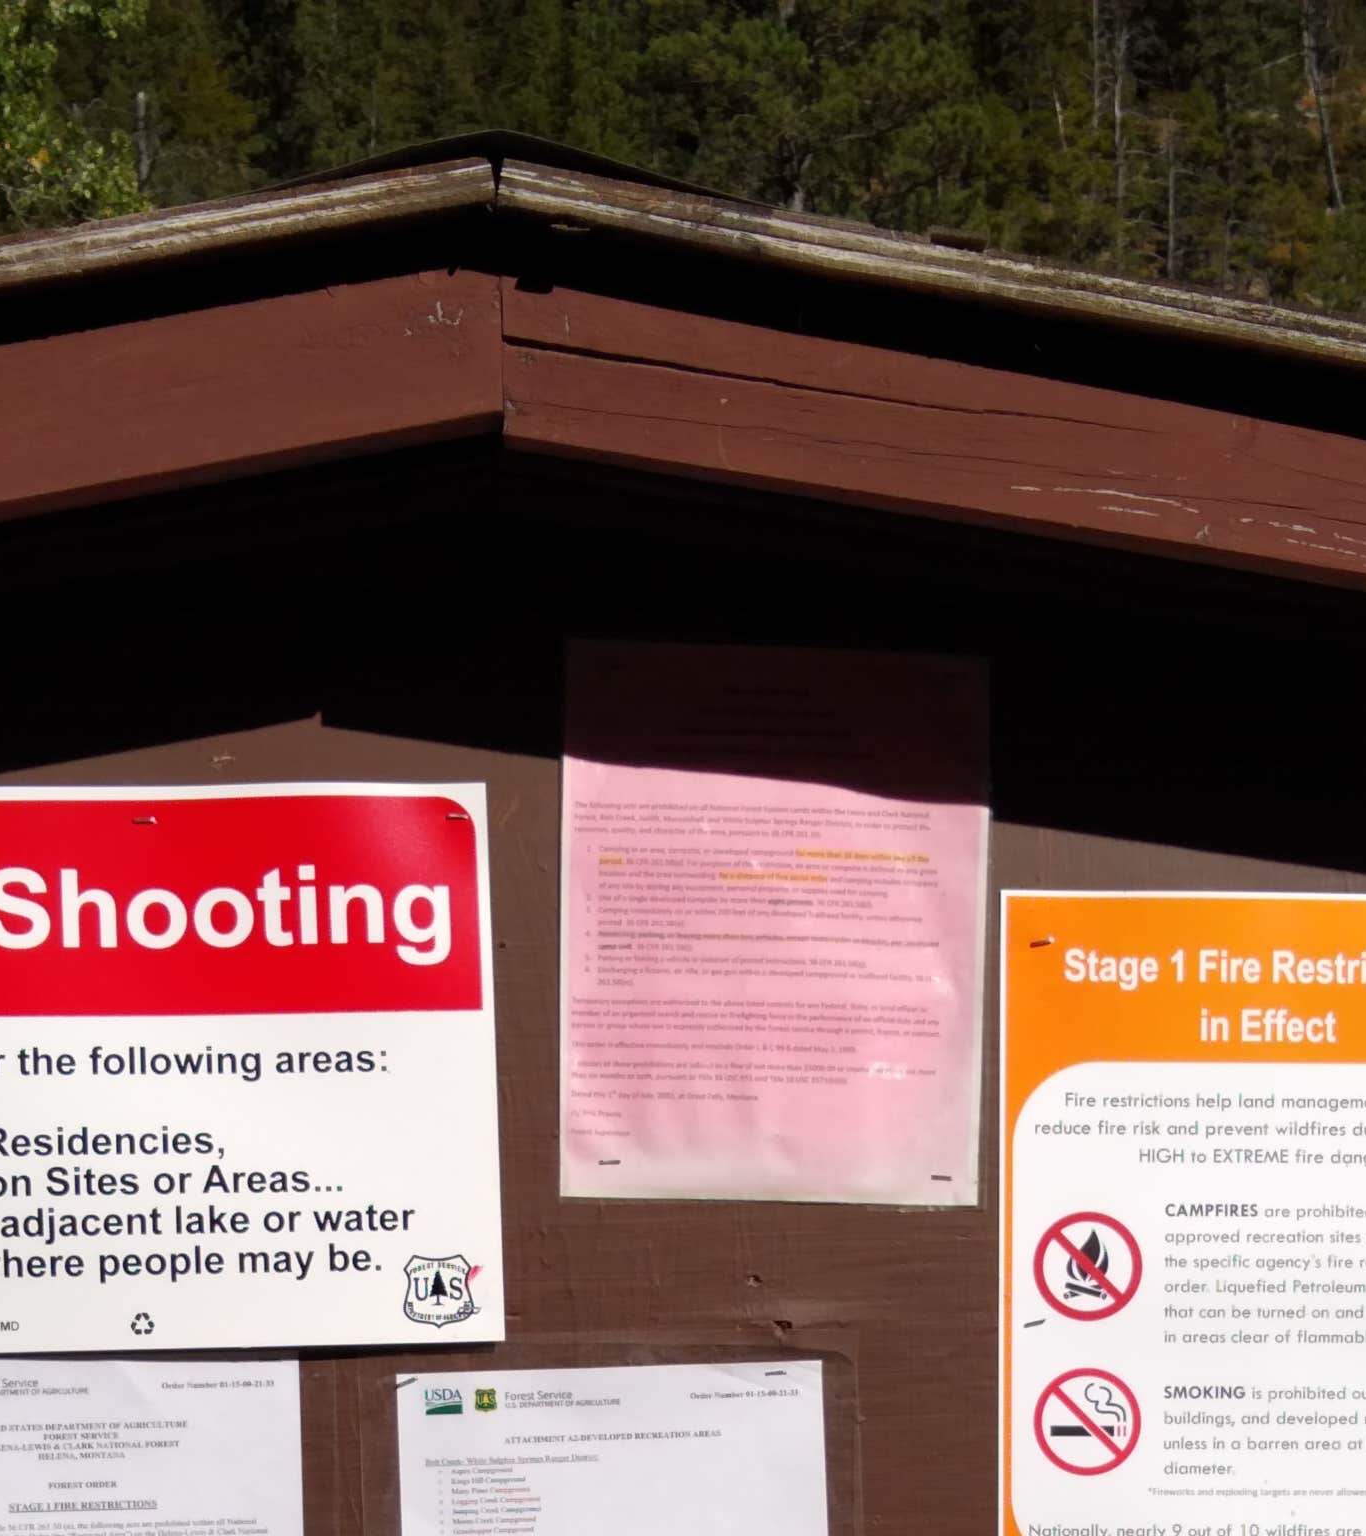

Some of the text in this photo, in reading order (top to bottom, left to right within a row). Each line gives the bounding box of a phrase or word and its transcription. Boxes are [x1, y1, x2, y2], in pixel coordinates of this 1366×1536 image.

[1064, 948, 1159, 991] Stage
[1170, 949, 1185, 983] 1
[1199, 948, 1262, 983] Fire
[1201, 1007, 1337, 1043] in Effect
[17, 1047, 76, 1075] the
[89, 1046, 261, 1082] following
[276, 1051, 386, 1073] areas:
[1065, 1092, 1096, 1107] Fire
[1103, 1094, 1190, 1108] restrictions
[1196, 1093, 1231, 1111] help
[1239, 1093, 1274, 1108] land
[1035, 1120, 1091, 1135] reduce
[1098, 1120, 1126, 1135] fire
[1133, 1121, 1160, 1135] risk
[1167, 1121, 1198, 1136] and
[1206, 1124, 1269, 1139] prevent
[1276, 1121, 1346, 1136] wildfires
[1139, 1148, 1184, 1163] HIGH
[1191, 1152, 1206, 1163] to
[1214, 1149, 1288, 1163] EXTREME
[1295, 1149, 1323, 1164] fire
[47, 1167, 139, 1196] Sites
[154, 1173, 192, 1194] or
[203, 1165, 342, 1193] Areas...
[1165, 1203, 1259, 1218] CAMPFIRES
[1264, 1207, 1290, 1219] are
[1, 1208, 162, 1245] adjacent
[176, 1205, 249, 1234] lake
[264, 1211, 301, 1233] or
[313, 1205, 414, 1231] water
[100, 1245, 224, 1283] people
[239, 1251, 314, 1280] may
[329, 1243, 381, 1272] be.
[0, 1321, 19, 1331] MD
[2, 1378, 38, 1388] Service
[425, 1388, 462, 1402] USDA
[505, 1390, 573, 1400] Forest Service
[1164, 1386, 1245, 1399] SMOKING
[1251, 1387, 1262, 1400] is
[1268, 1387, 1346, 1402] prohibited
[54, 1502, 78, 1511] FIRE
